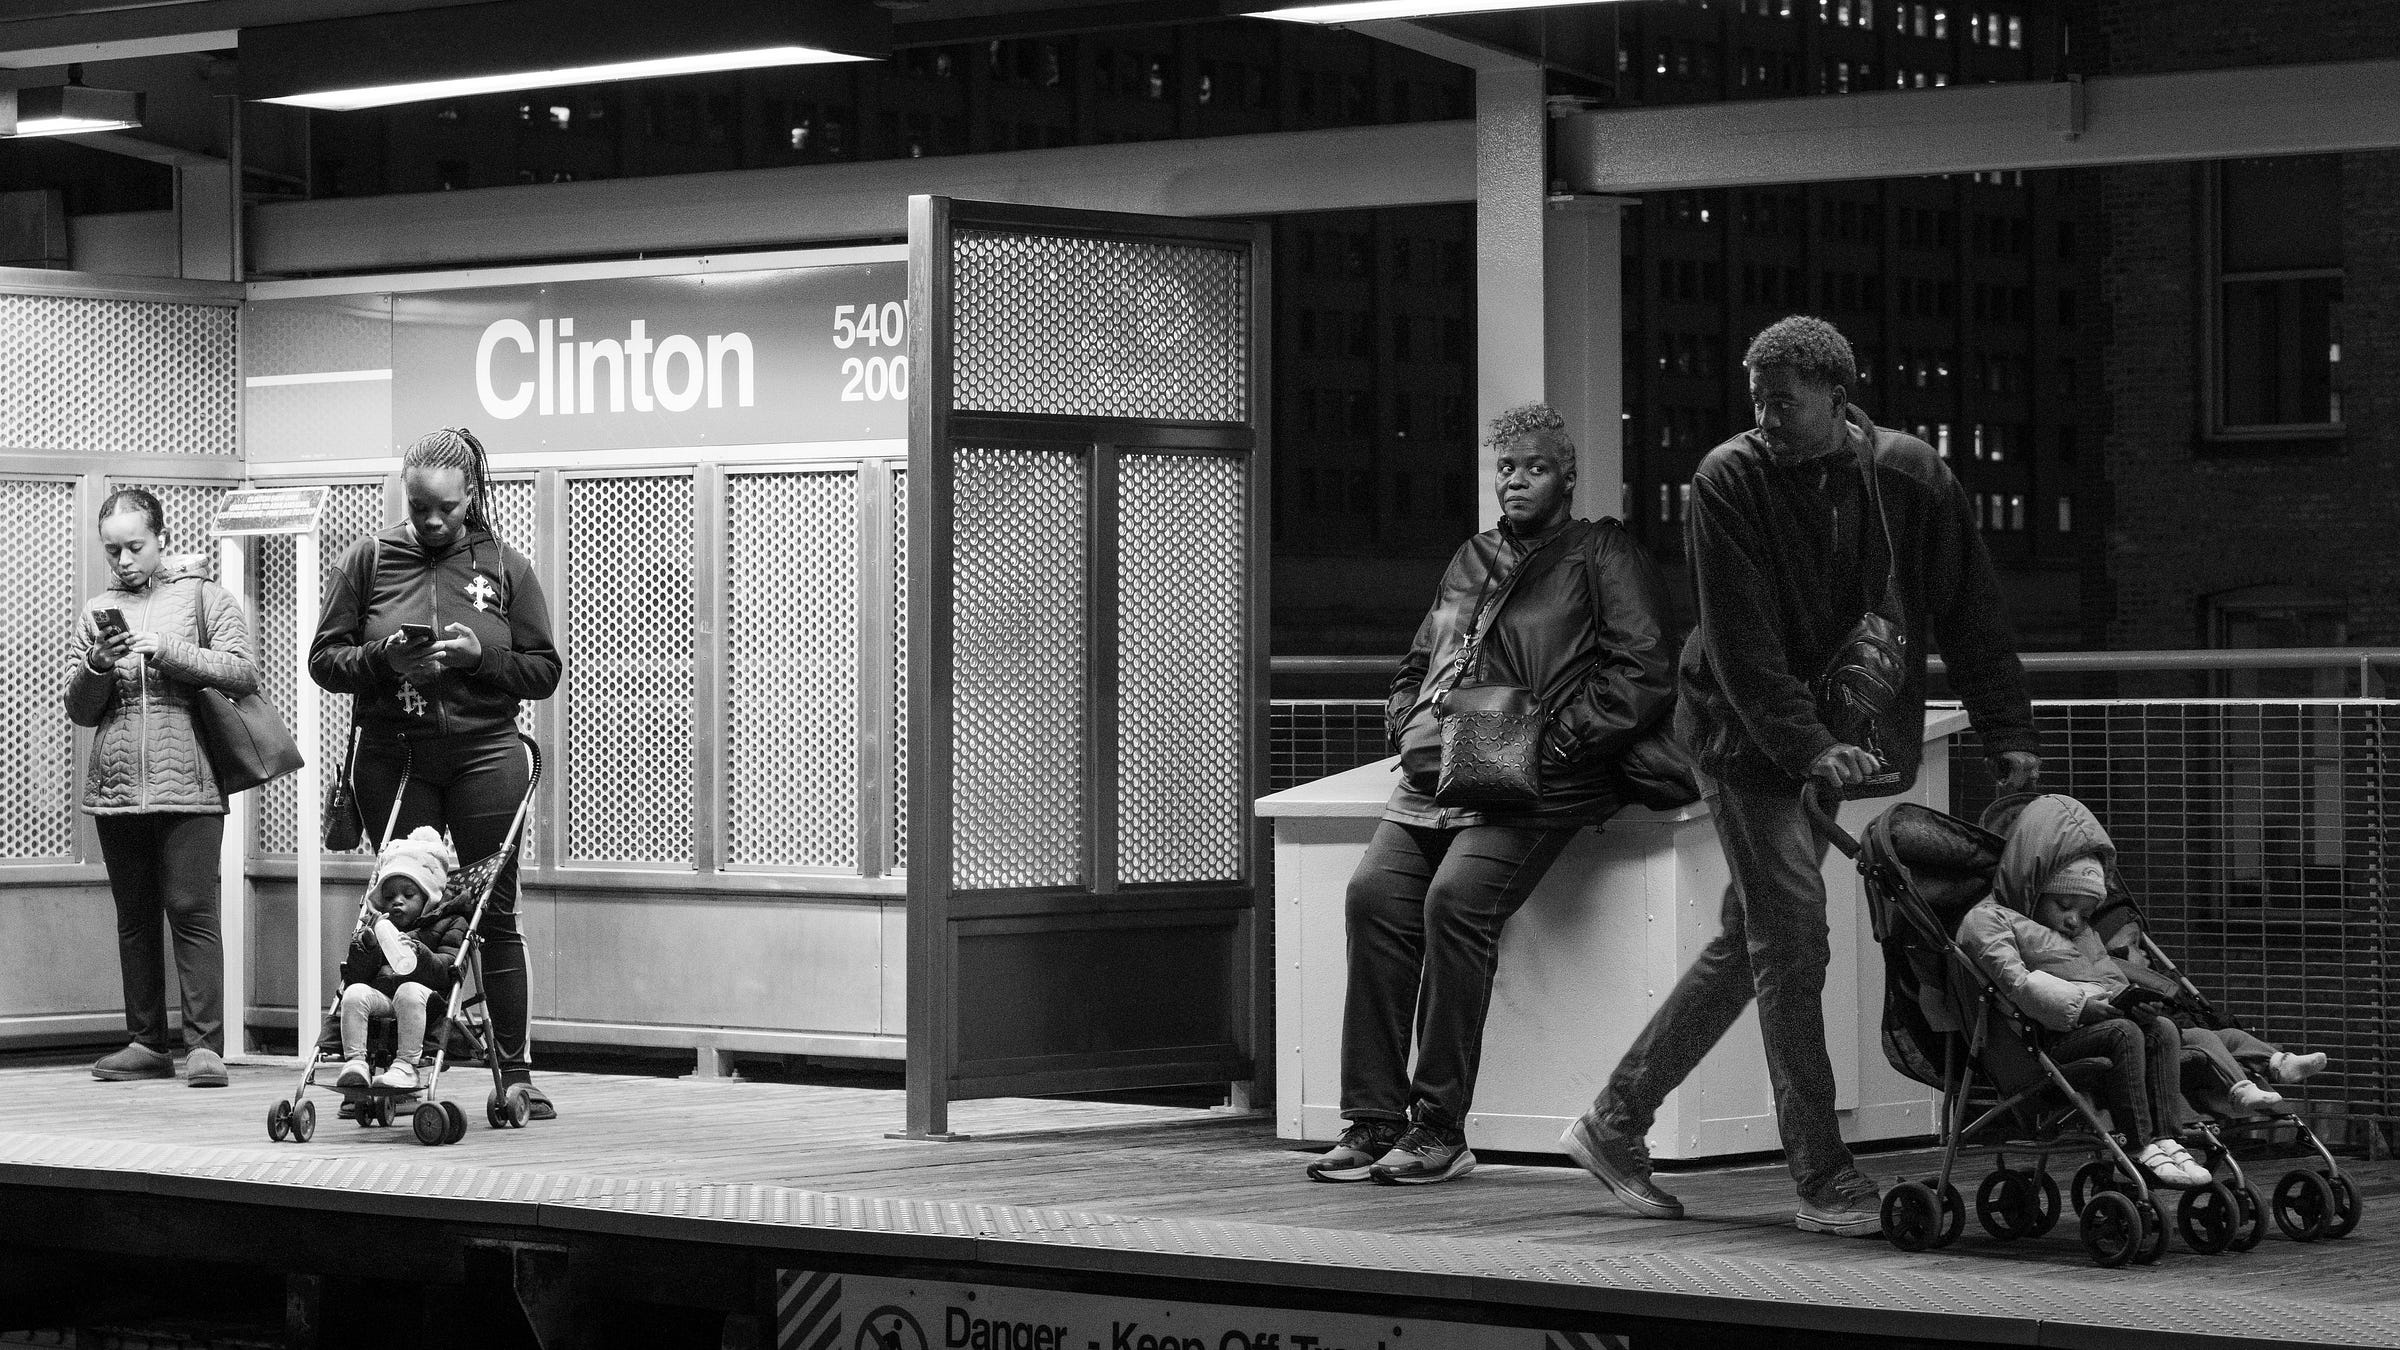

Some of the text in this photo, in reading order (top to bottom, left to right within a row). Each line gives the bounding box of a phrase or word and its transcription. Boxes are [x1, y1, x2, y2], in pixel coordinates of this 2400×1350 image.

[833, 300, 909, 348] 540
[476, 318, 754, 419] Clinton
[946, 1306, 1067, 1350] Danger
